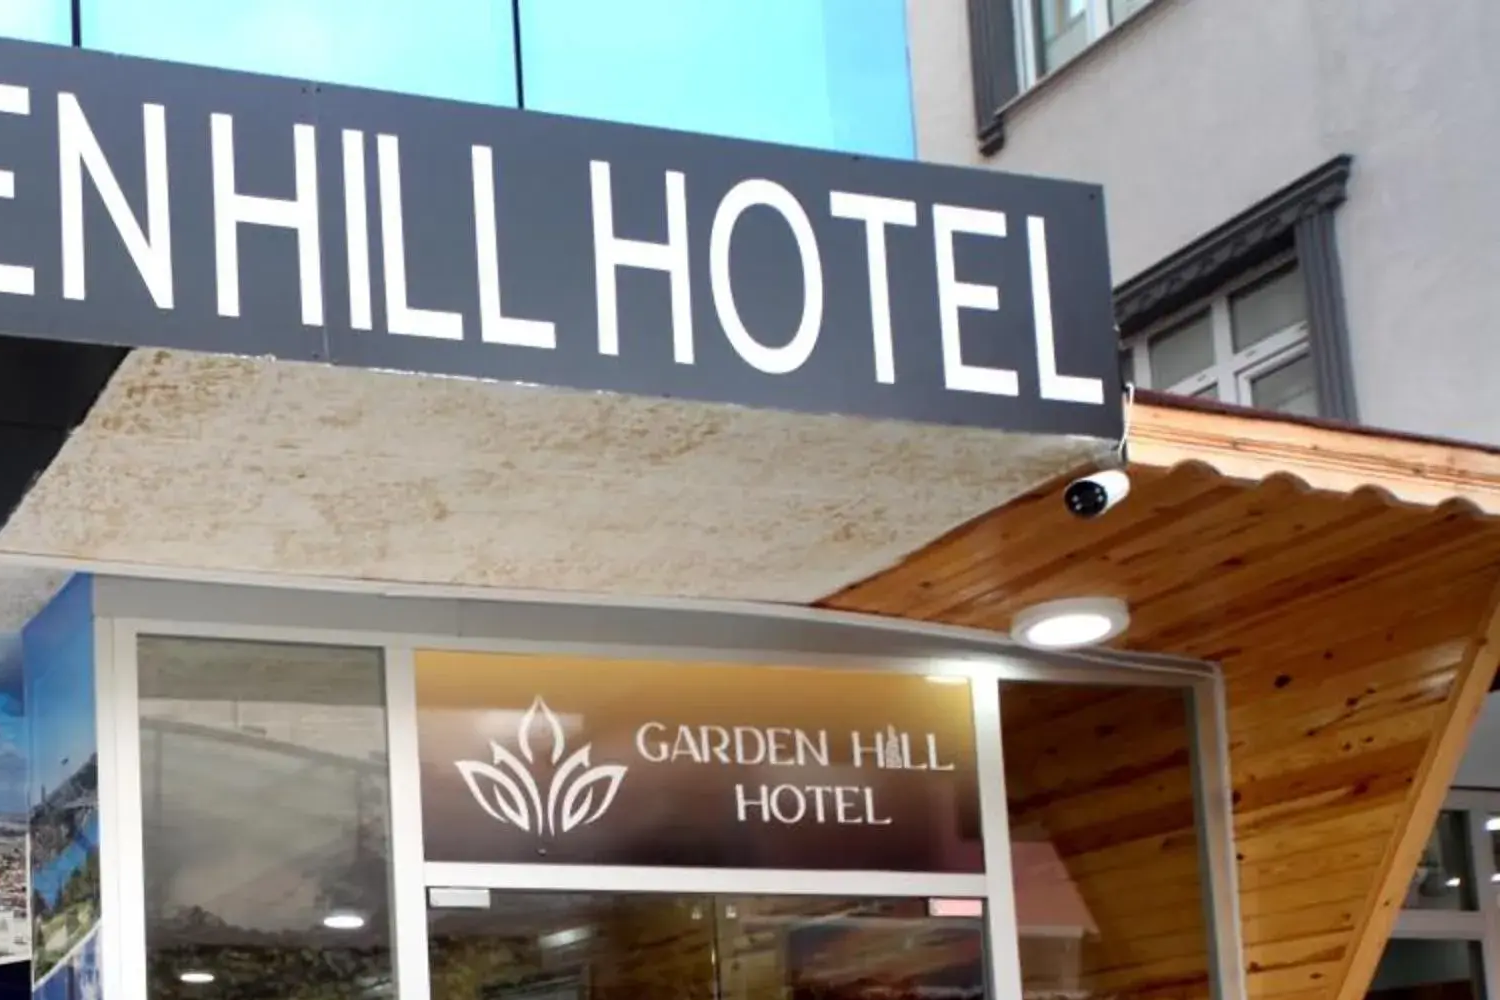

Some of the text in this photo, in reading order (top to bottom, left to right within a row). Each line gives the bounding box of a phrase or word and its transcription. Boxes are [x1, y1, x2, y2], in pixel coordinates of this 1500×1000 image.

[210, 112, 556, 350] HILL
[589, 159, 1104, 404] HOTEL
[635, 721, 955, 772] GARDEN HILL
[734, 783, 893, 826] HOTEL
